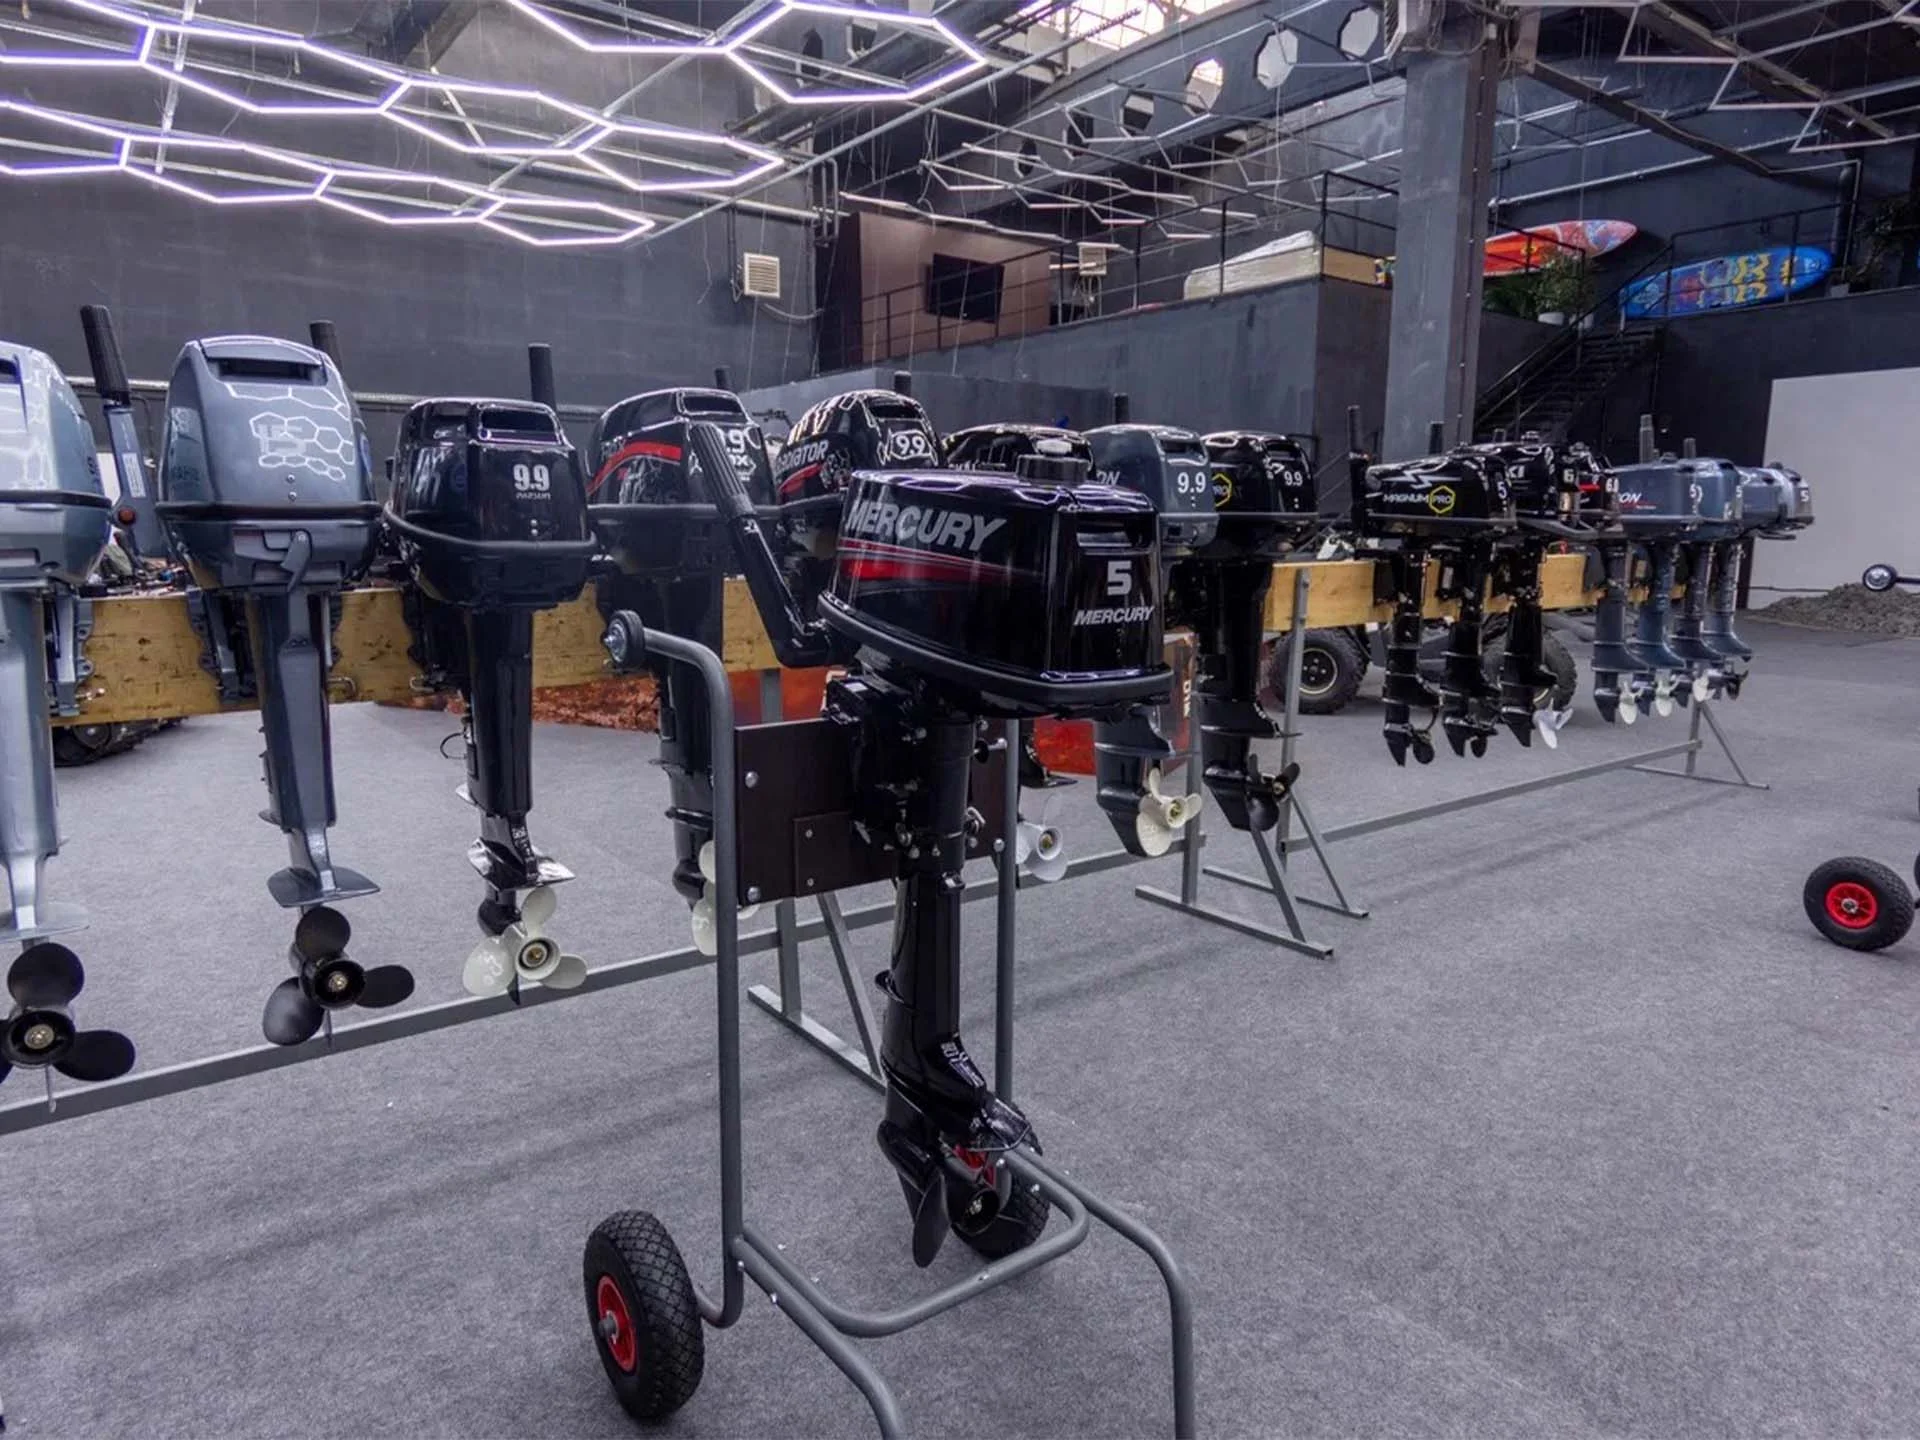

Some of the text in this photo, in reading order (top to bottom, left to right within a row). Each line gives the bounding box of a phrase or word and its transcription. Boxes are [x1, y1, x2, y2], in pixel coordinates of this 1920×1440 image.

[895, 434, 925, 456] 9.9
[512, 463, 551, 491] 9.9
[1177, 471, 1206, 494] 9.9
[1283, 470, 1303, 487] 9.9
[1497, 481, 1508, 499] 5
[848, 499, 1006, 550] MERCURY
[1106, 560, 1133, 596] 5
[1073, 605, 1155, 626] MERCURY
